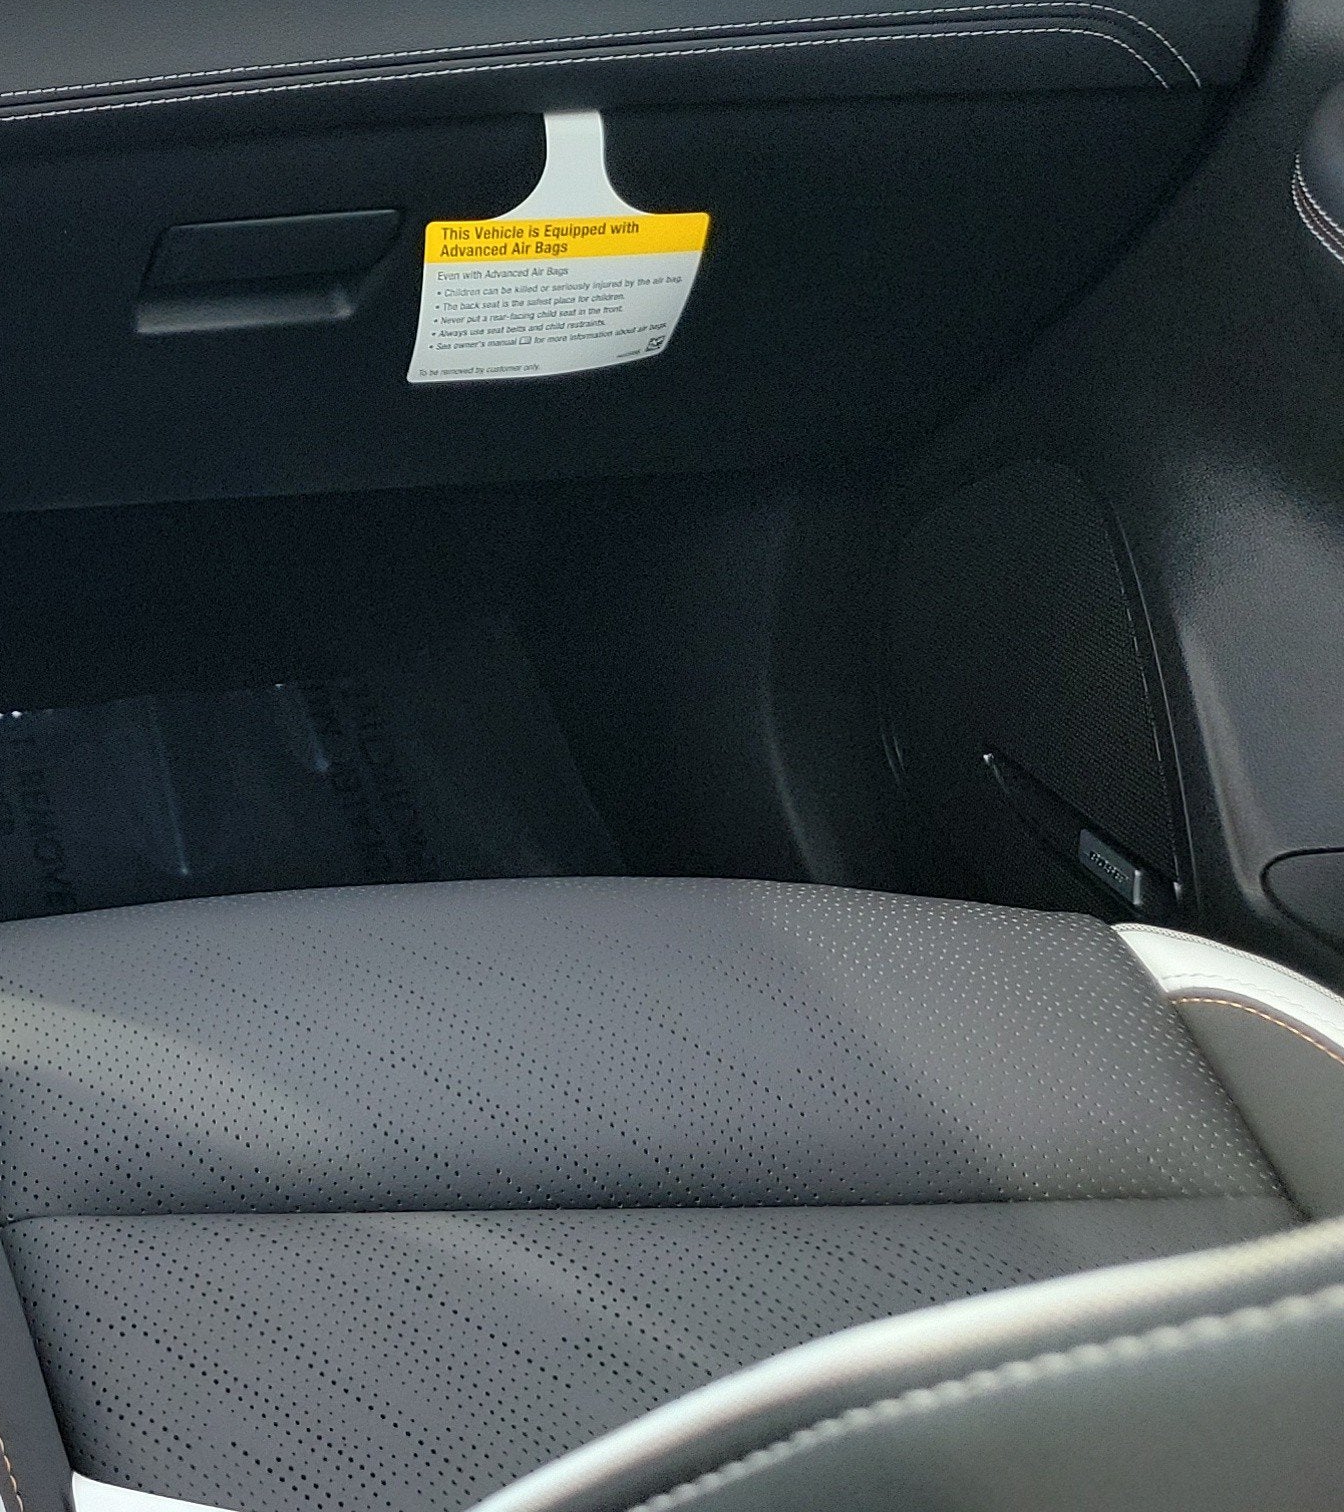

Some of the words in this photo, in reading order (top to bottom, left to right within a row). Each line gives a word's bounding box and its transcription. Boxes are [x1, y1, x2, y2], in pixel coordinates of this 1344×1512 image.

[442, 227, 470, 240] This
[475, 226, 524, 239] Vehicle
[528, 225, 539, 238] is
[544, 223, 607, 238] Equipped
[610, 221, 639, 234] with
[440, 242, 507, 257] Advanced
[512, 242, 531, 255] Air
[535, 242, 568, 256] Bags
[437, 271, 460, 281] Even
[463, 270, 482, 280] with
[485, 268, 529, 278] Advanced
[531, 267, 544, 276] Air
[546, 267, 568, 277] Bags
